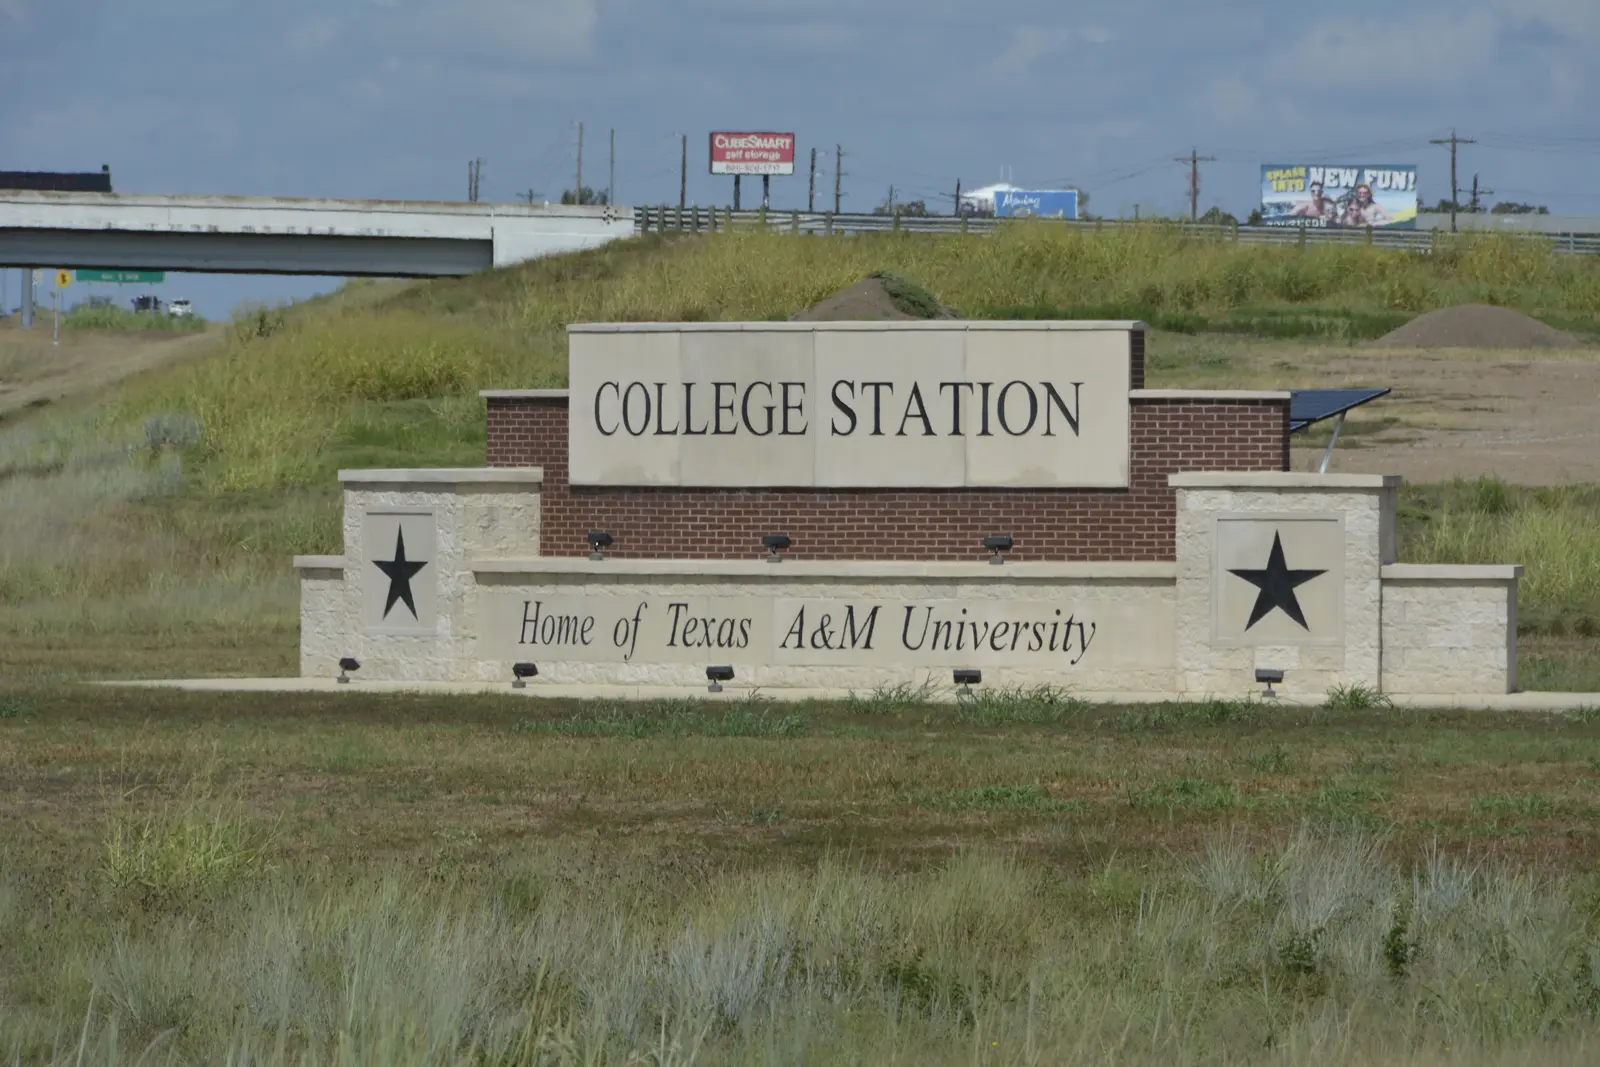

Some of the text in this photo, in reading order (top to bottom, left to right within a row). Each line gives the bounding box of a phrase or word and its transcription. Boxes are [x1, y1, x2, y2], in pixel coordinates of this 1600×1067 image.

[745, 150, 781, 162] storage
[1271, 180, 1304, 192] INTO
[1309, 166, 1416, 191] NEW FUN!
[594, 379, 1085, 437] COLLEGE STATION
[518, 600, 1097, 666] Home of Texas A&M University
